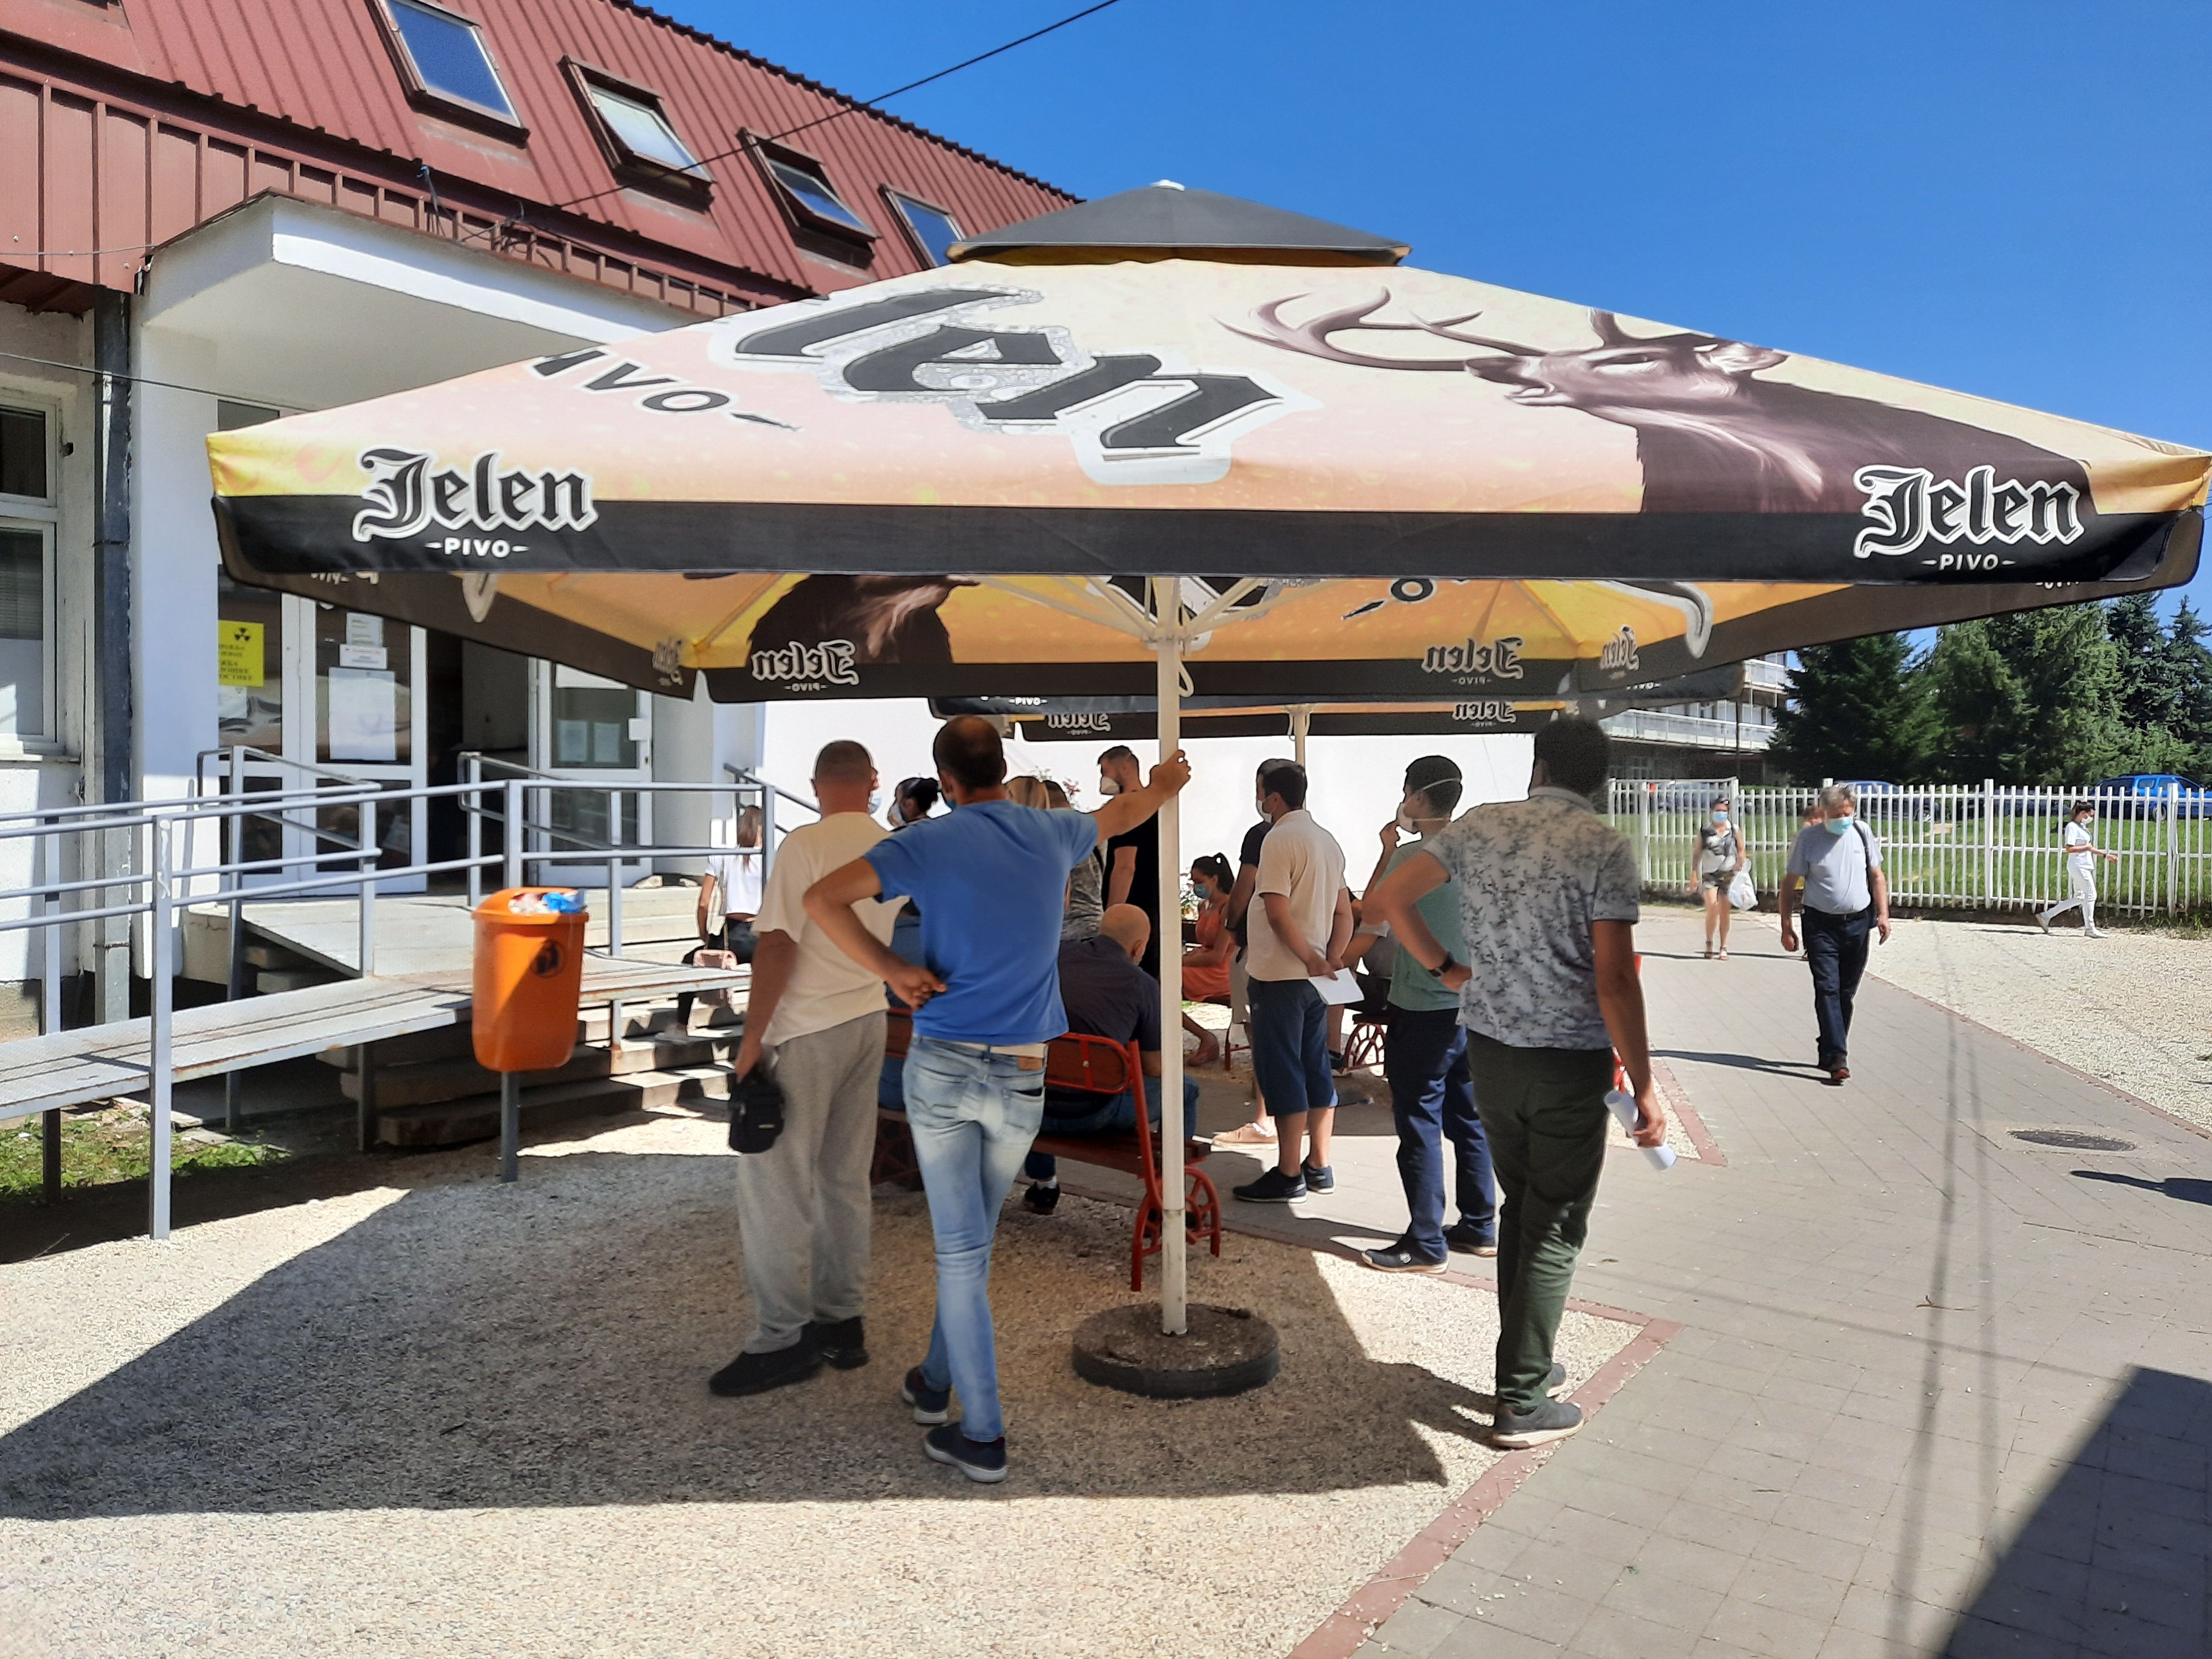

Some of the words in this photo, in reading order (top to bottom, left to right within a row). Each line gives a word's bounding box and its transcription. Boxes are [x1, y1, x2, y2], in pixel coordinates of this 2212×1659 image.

[724, 284, 1300, 474] len
[352, 445, 599, 543] Jelen
[1853, 463, 2085, 559] Jelen
